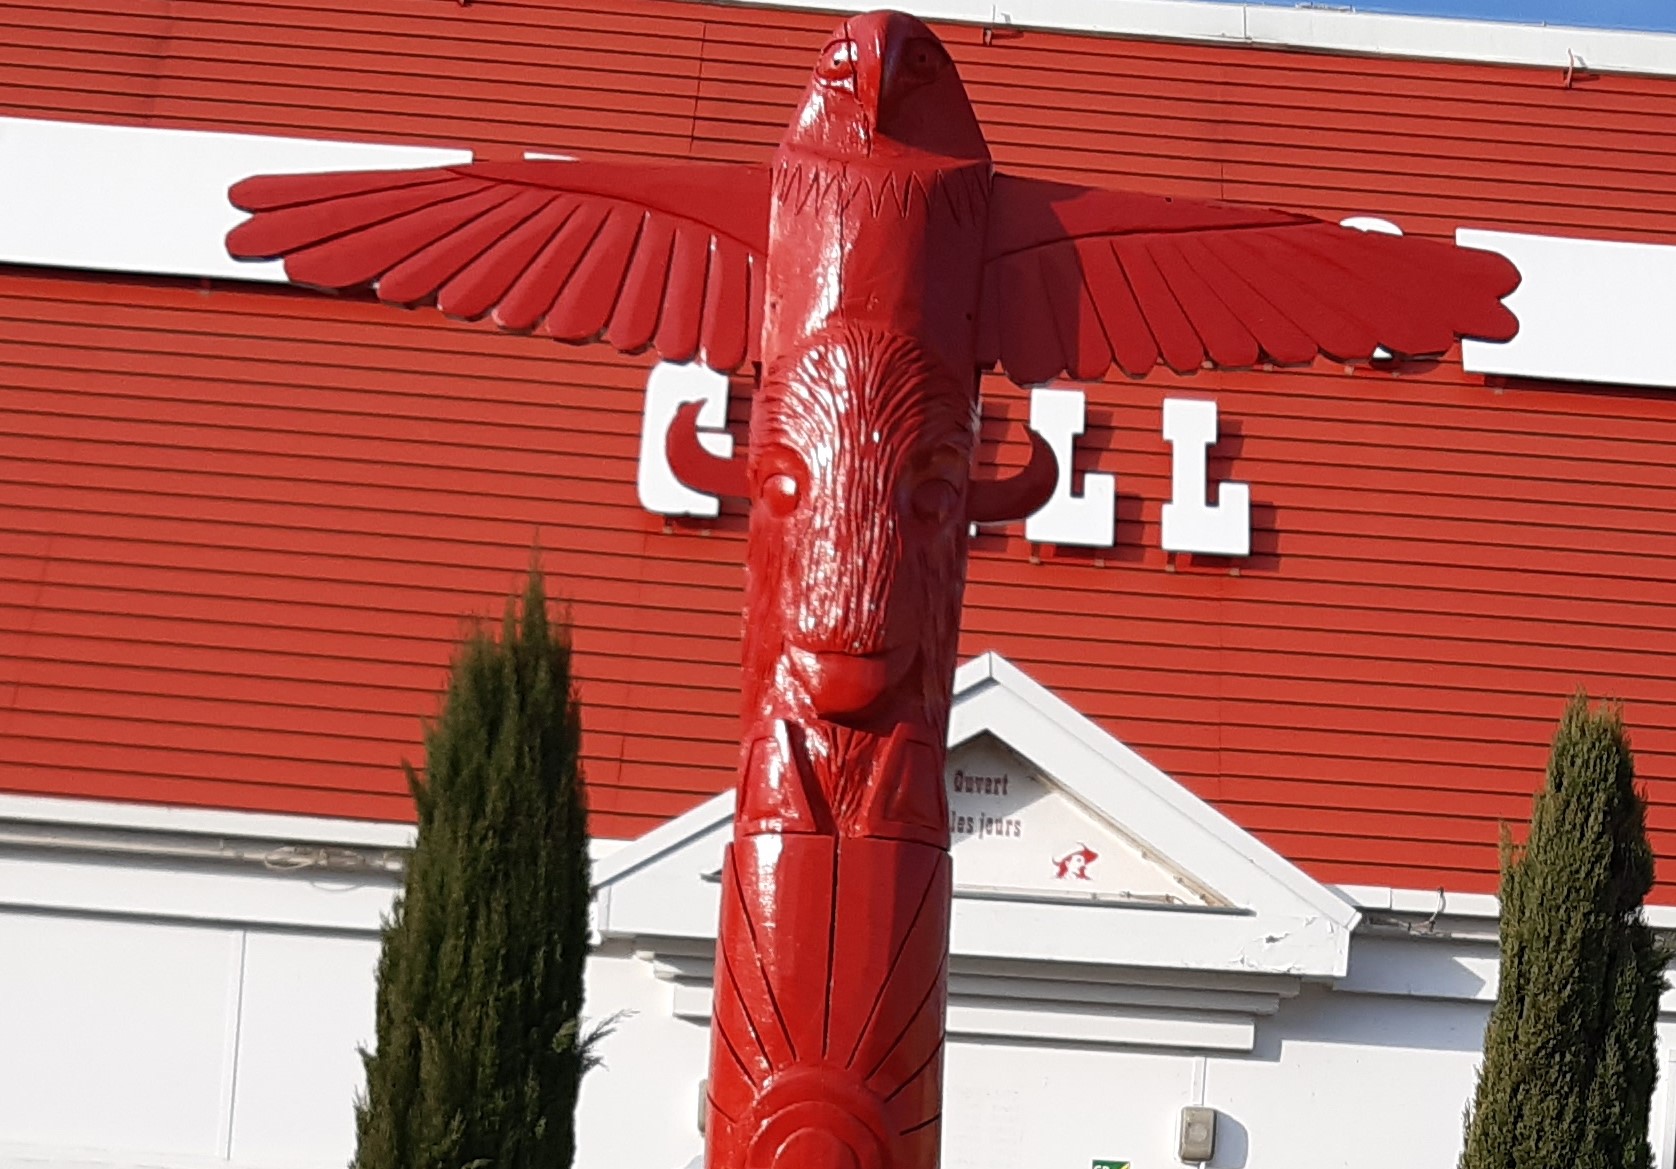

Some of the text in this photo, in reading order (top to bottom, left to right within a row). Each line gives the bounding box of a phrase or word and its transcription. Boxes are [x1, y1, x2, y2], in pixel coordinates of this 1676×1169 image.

[638, 361, 1251, 556] GLL
[953, 770, 1009, 796] Ouvert
[978, 812, 1022, 839] jours
